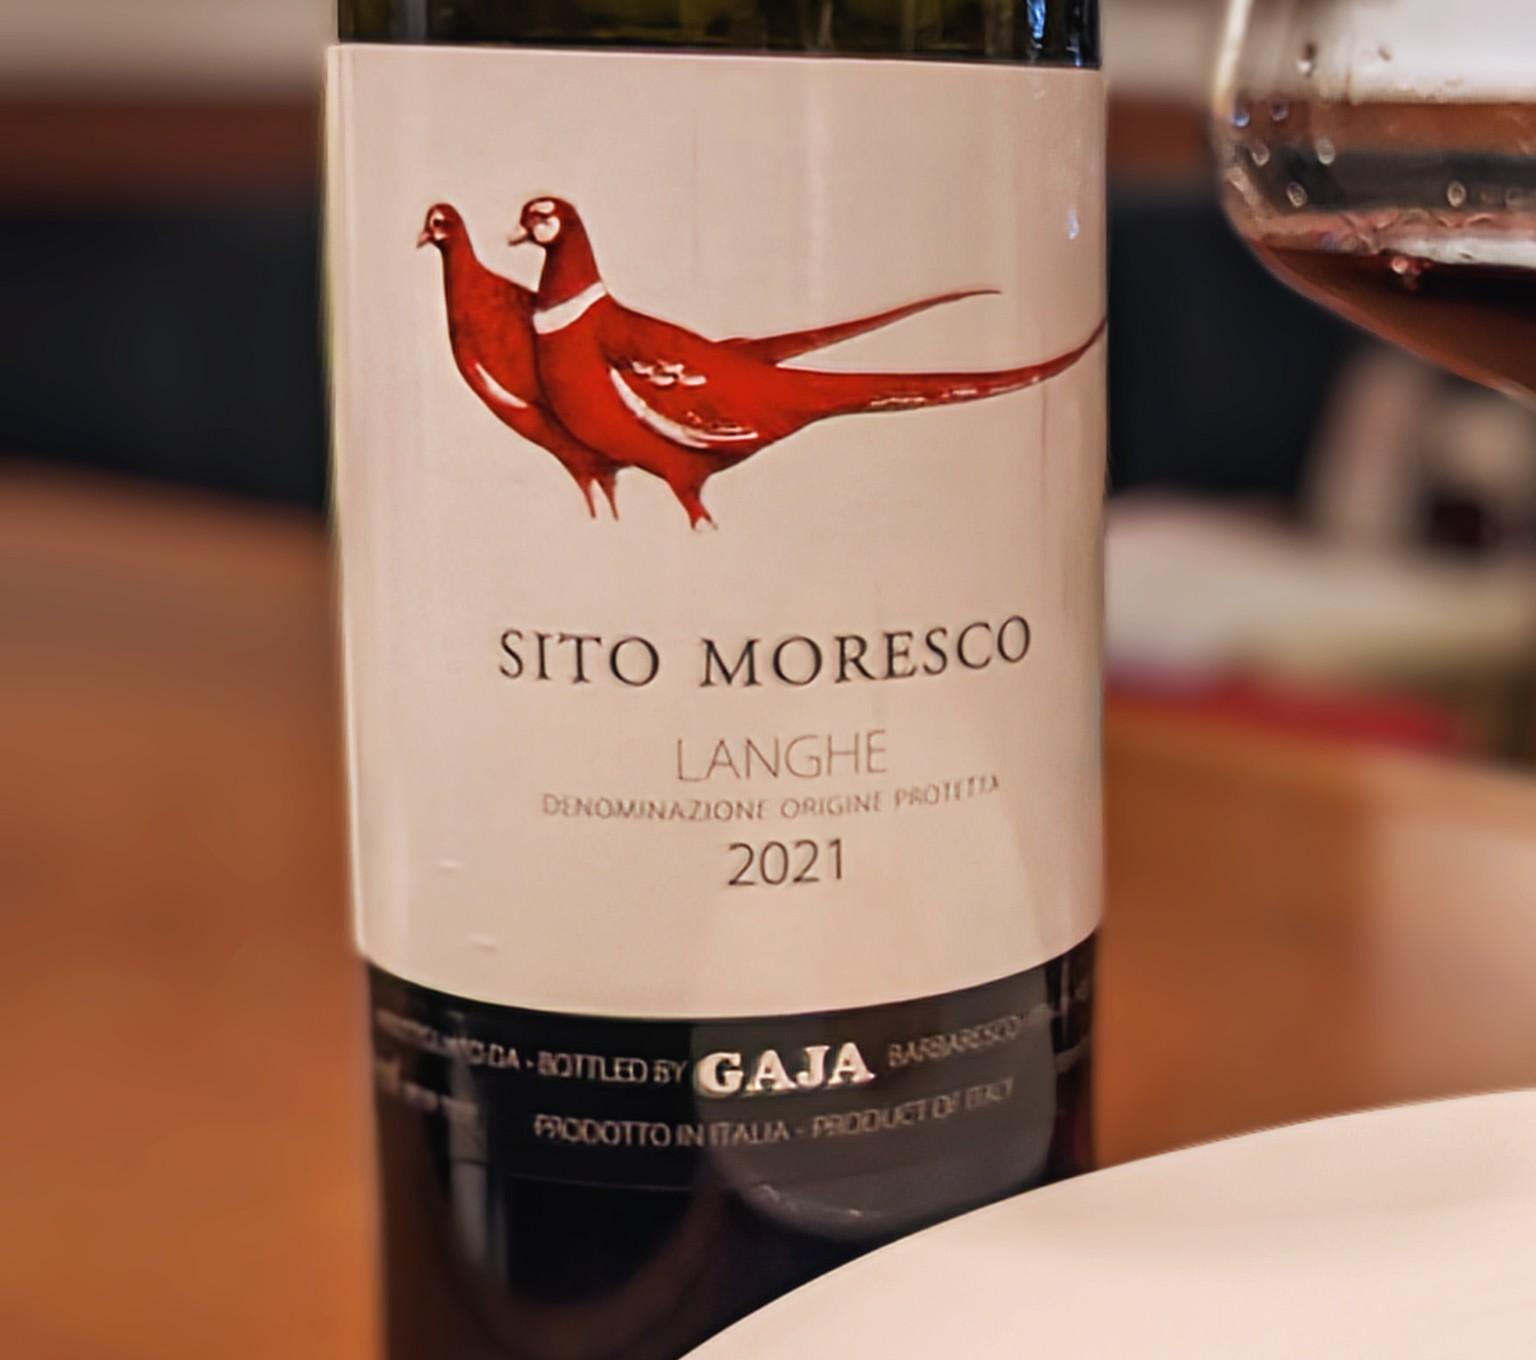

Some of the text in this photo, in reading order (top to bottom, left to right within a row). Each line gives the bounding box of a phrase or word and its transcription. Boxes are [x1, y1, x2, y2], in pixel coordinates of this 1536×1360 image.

[499, 615, 1032, 689] SITO MORESCO
[675, 729, 888, 783] LANGHE
[542, 773, 1000, 822] DENOMINAZIONE ORIGINE PROTETTA
[727, 838, 843, 887] 2021
[537, 1050, 648, 1084] BOTTLED
[654, 1057, 688, 1084] BY
[696, 1040, 876, 1097] GAJA
[533, 1113, 672, 1147] PRODOTTO
[677, 1122, 704, 1148] IN
[711, 1120, 790, 1148] ITALIA
[812, 1099, 927, 1138] PRODUCT
[932, 1093, 962, 1119] OF
